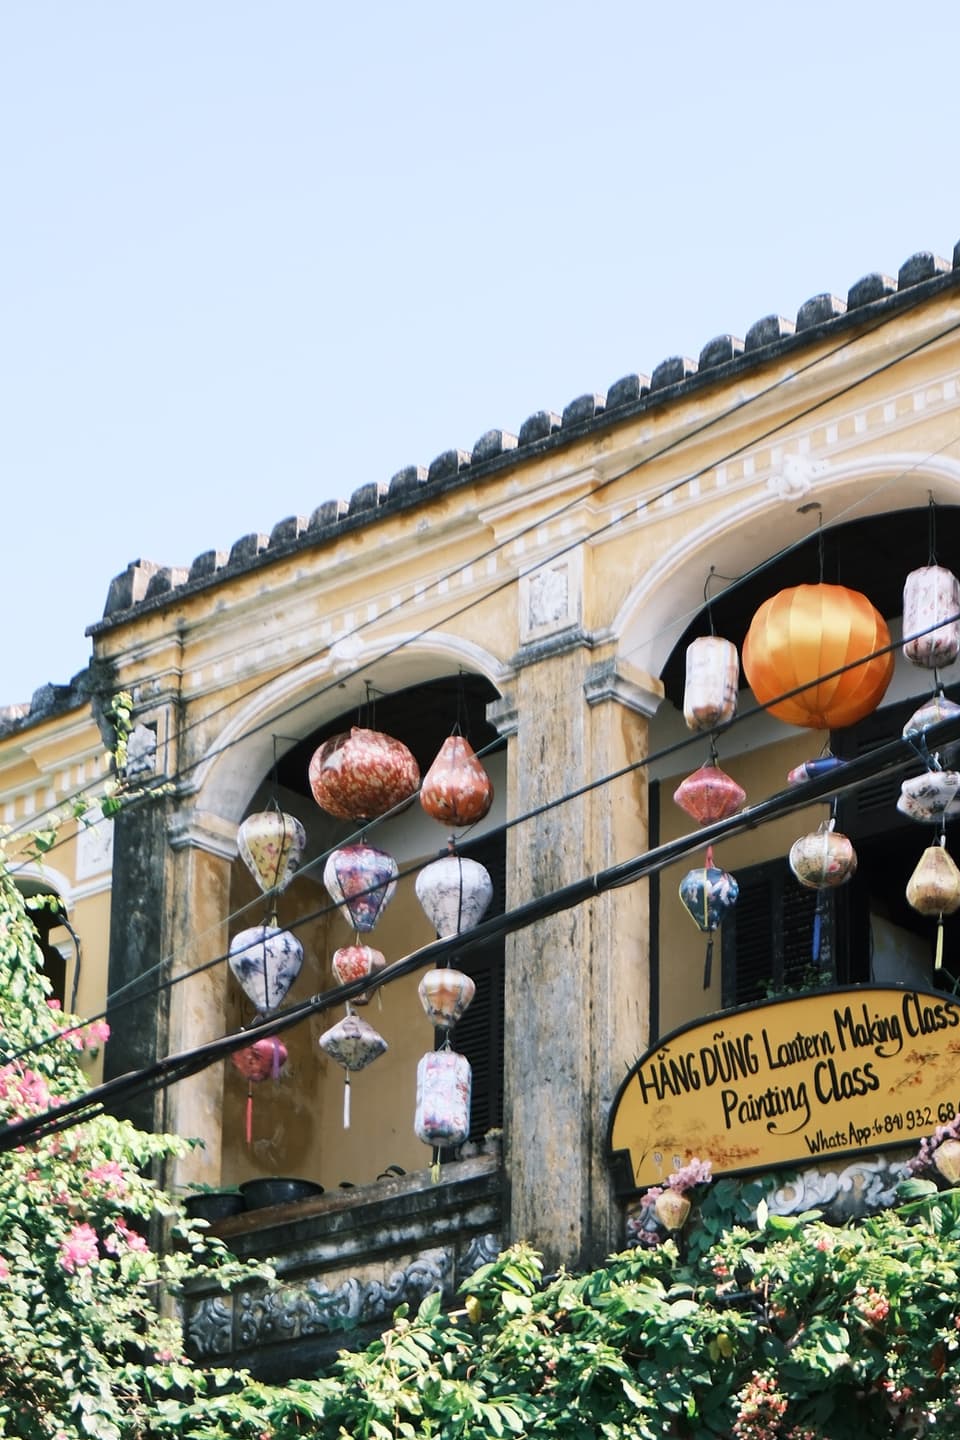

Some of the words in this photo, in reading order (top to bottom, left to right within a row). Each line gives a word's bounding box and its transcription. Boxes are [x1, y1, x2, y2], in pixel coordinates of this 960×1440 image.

[699, 1030, 759, 1087] DŨNG
[761, 1028, 836, 1070] Lantern
[833, 1003, 904, 1058] Making
[901, 991, 960, 1038] Class
[721, 1081, 811, 1136] Painting
[813, 1057, 881, 1105] Class
